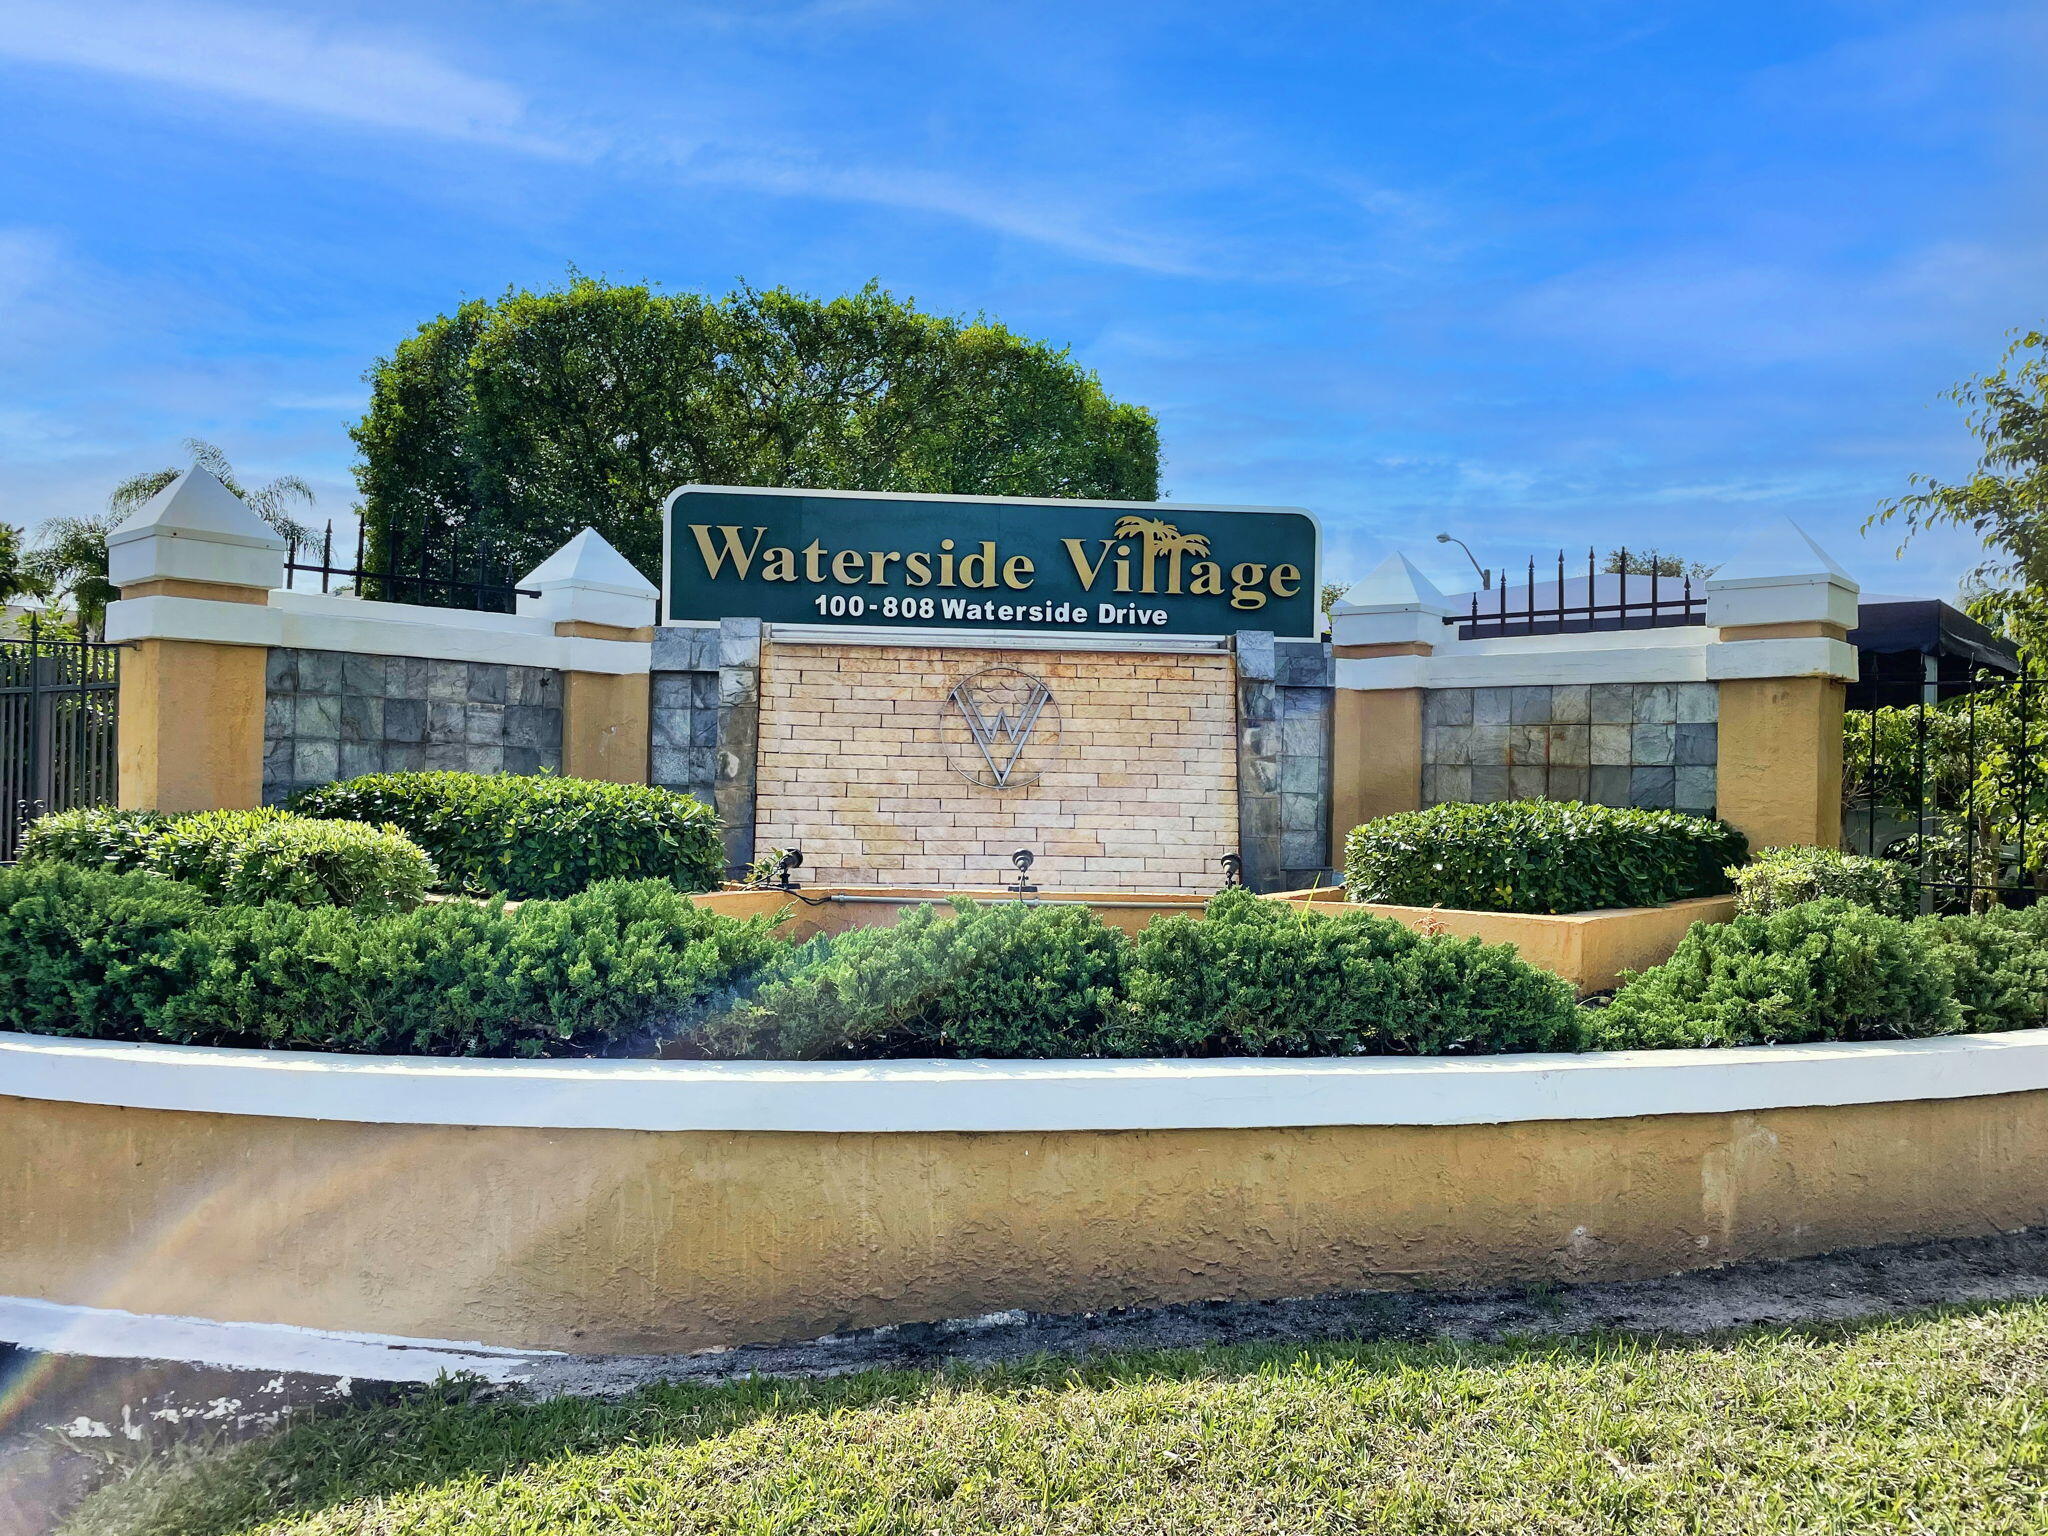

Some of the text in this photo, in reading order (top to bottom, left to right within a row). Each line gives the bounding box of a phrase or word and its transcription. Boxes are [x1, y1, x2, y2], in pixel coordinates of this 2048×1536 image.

[688, 515, 1301, 610] Waterside Village
[815, 594, 1169, 626] 100-808 Waterside Drive
